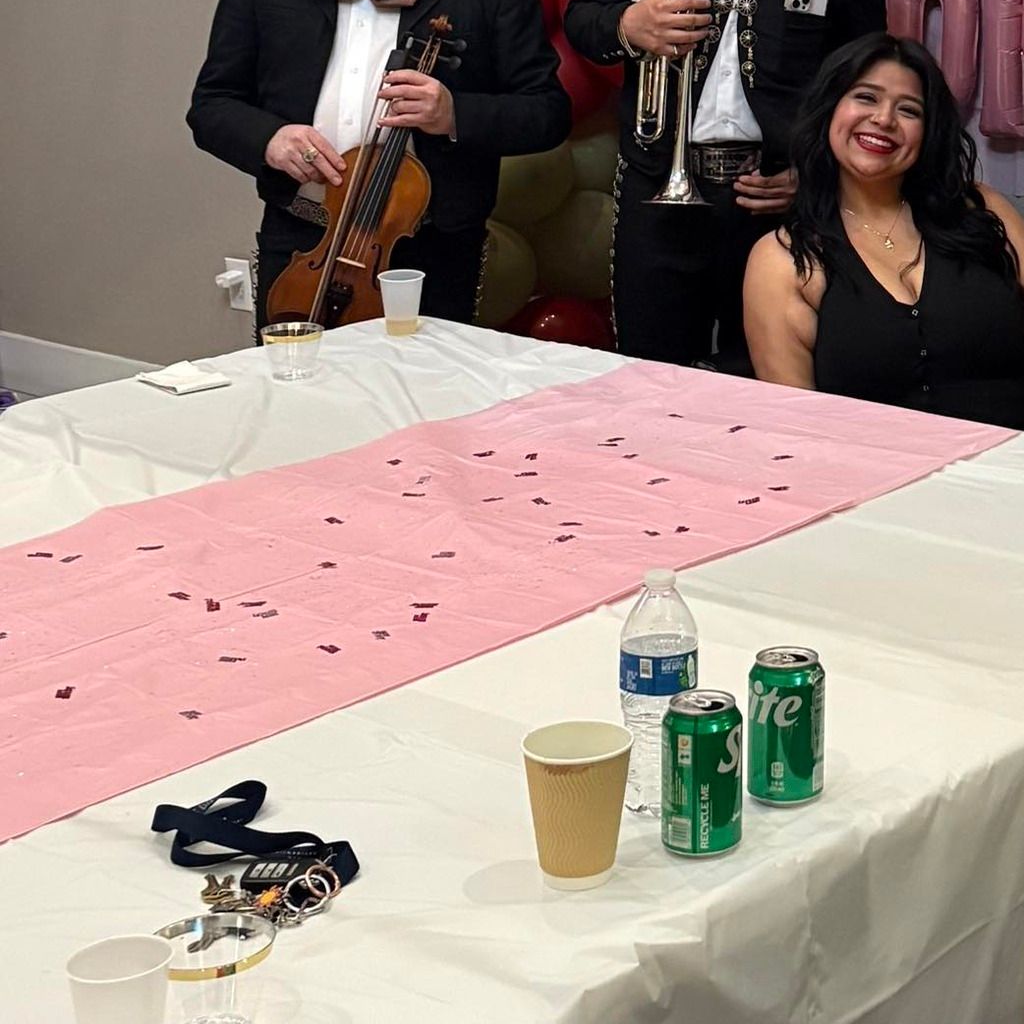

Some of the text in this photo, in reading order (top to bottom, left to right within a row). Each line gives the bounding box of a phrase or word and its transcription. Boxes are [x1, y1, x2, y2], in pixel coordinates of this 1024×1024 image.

[749, 680, 803, 727] ite
[700, 783, 710, 849] RECYCLE ME
